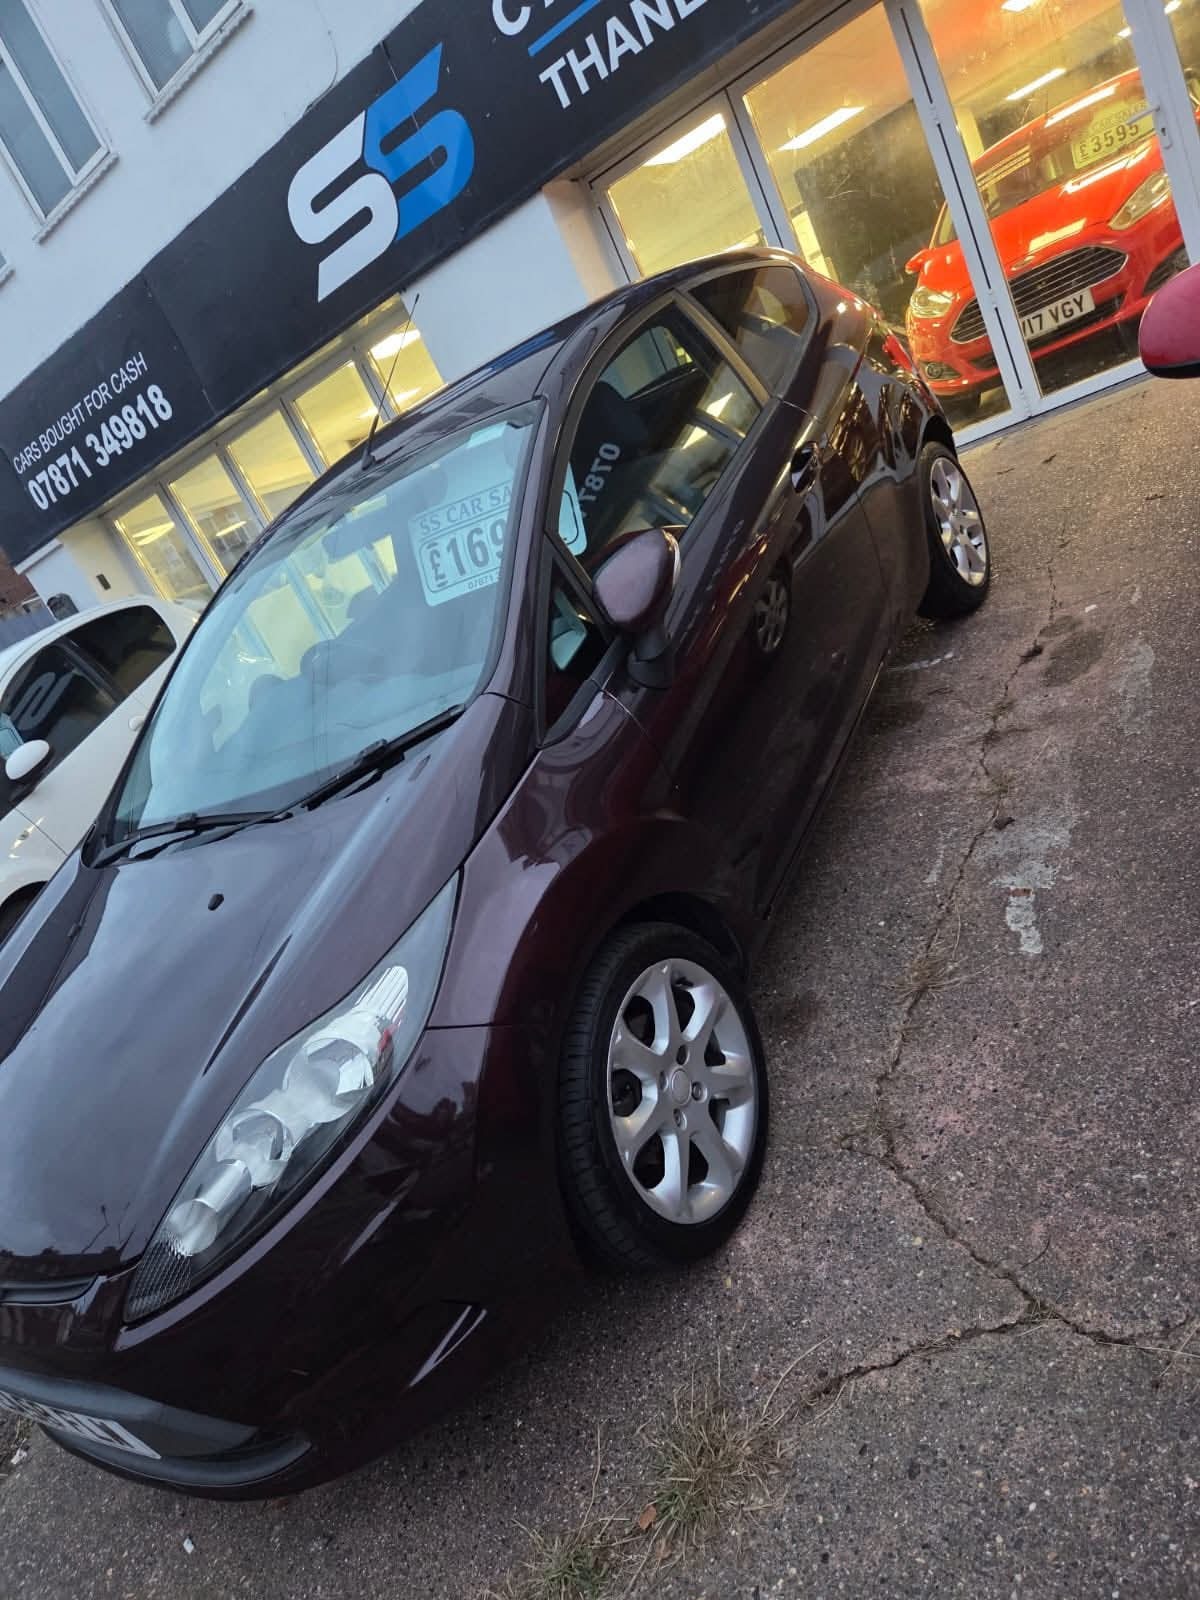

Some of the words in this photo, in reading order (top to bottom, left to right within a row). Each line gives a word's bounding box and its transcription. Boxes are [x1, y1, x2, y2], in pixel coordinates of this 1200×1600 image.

[287, 42, 475, 303] SS
[1079, 124, 1139, 160] £3595
[1022, 314, 1043, 337] 17
[1048, 295, 1084, 323] VGY
[14, 441, 42, 474] CARS
[39, 402, 86, 453] BOUGHT
[83, 382, 113, 417] FOR
[110, 351, 148, 394] CASH
[28, 446, 93, 510] 07871
[85, 384, 173, 466] 349818
[420, 513, 441, 536] SS
[446, 500, 484, 523] CAR
